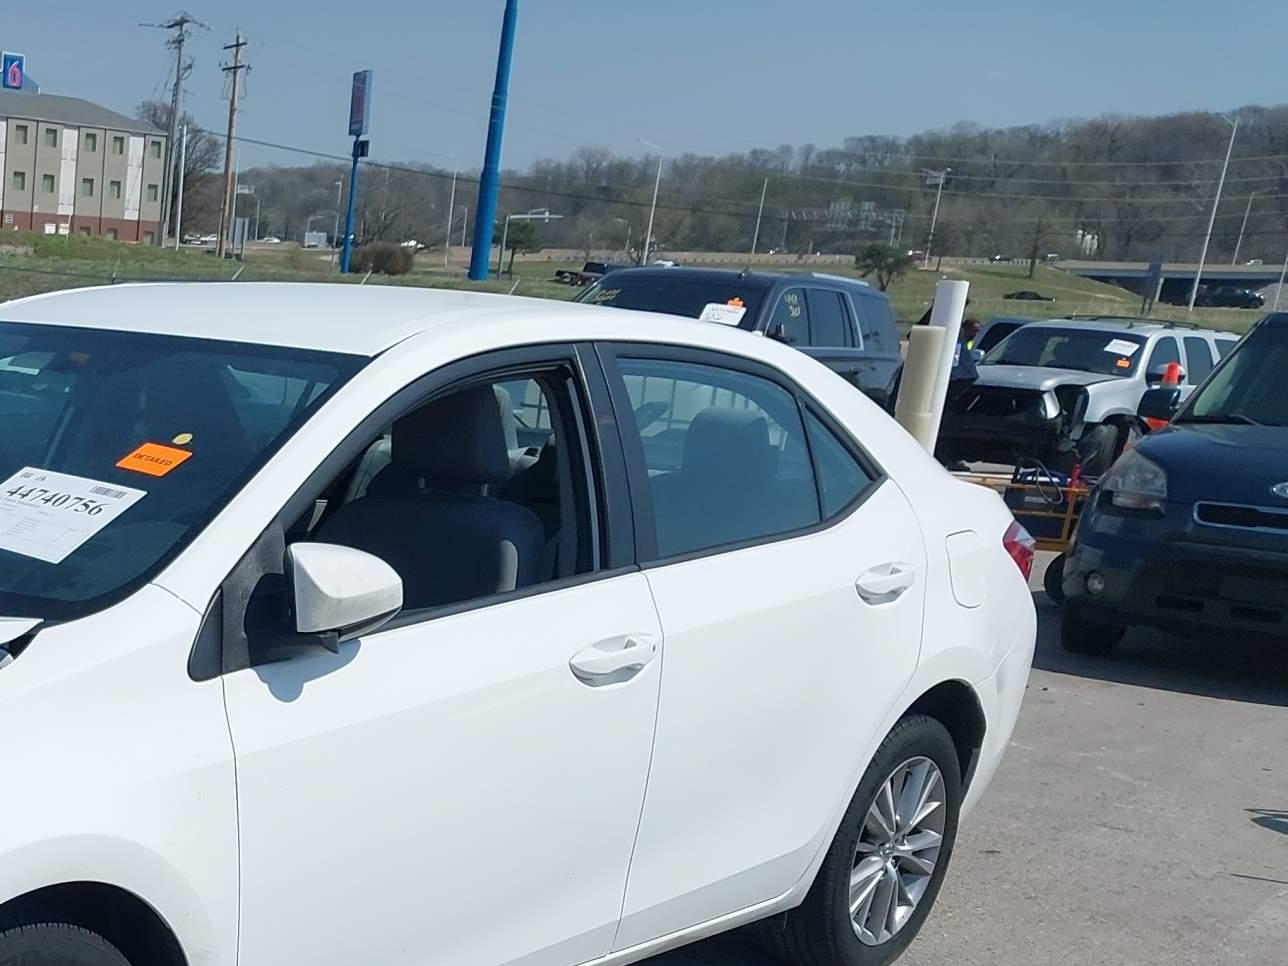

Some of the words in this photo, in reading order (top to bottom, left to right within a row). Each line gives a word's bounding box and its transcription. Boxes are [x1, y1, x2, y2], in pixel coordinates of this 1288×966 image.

[8, 60, 20, 88] 6
[133, 453, 173, 466] DETAILED
[7, 485, 109, 517] 44740756
